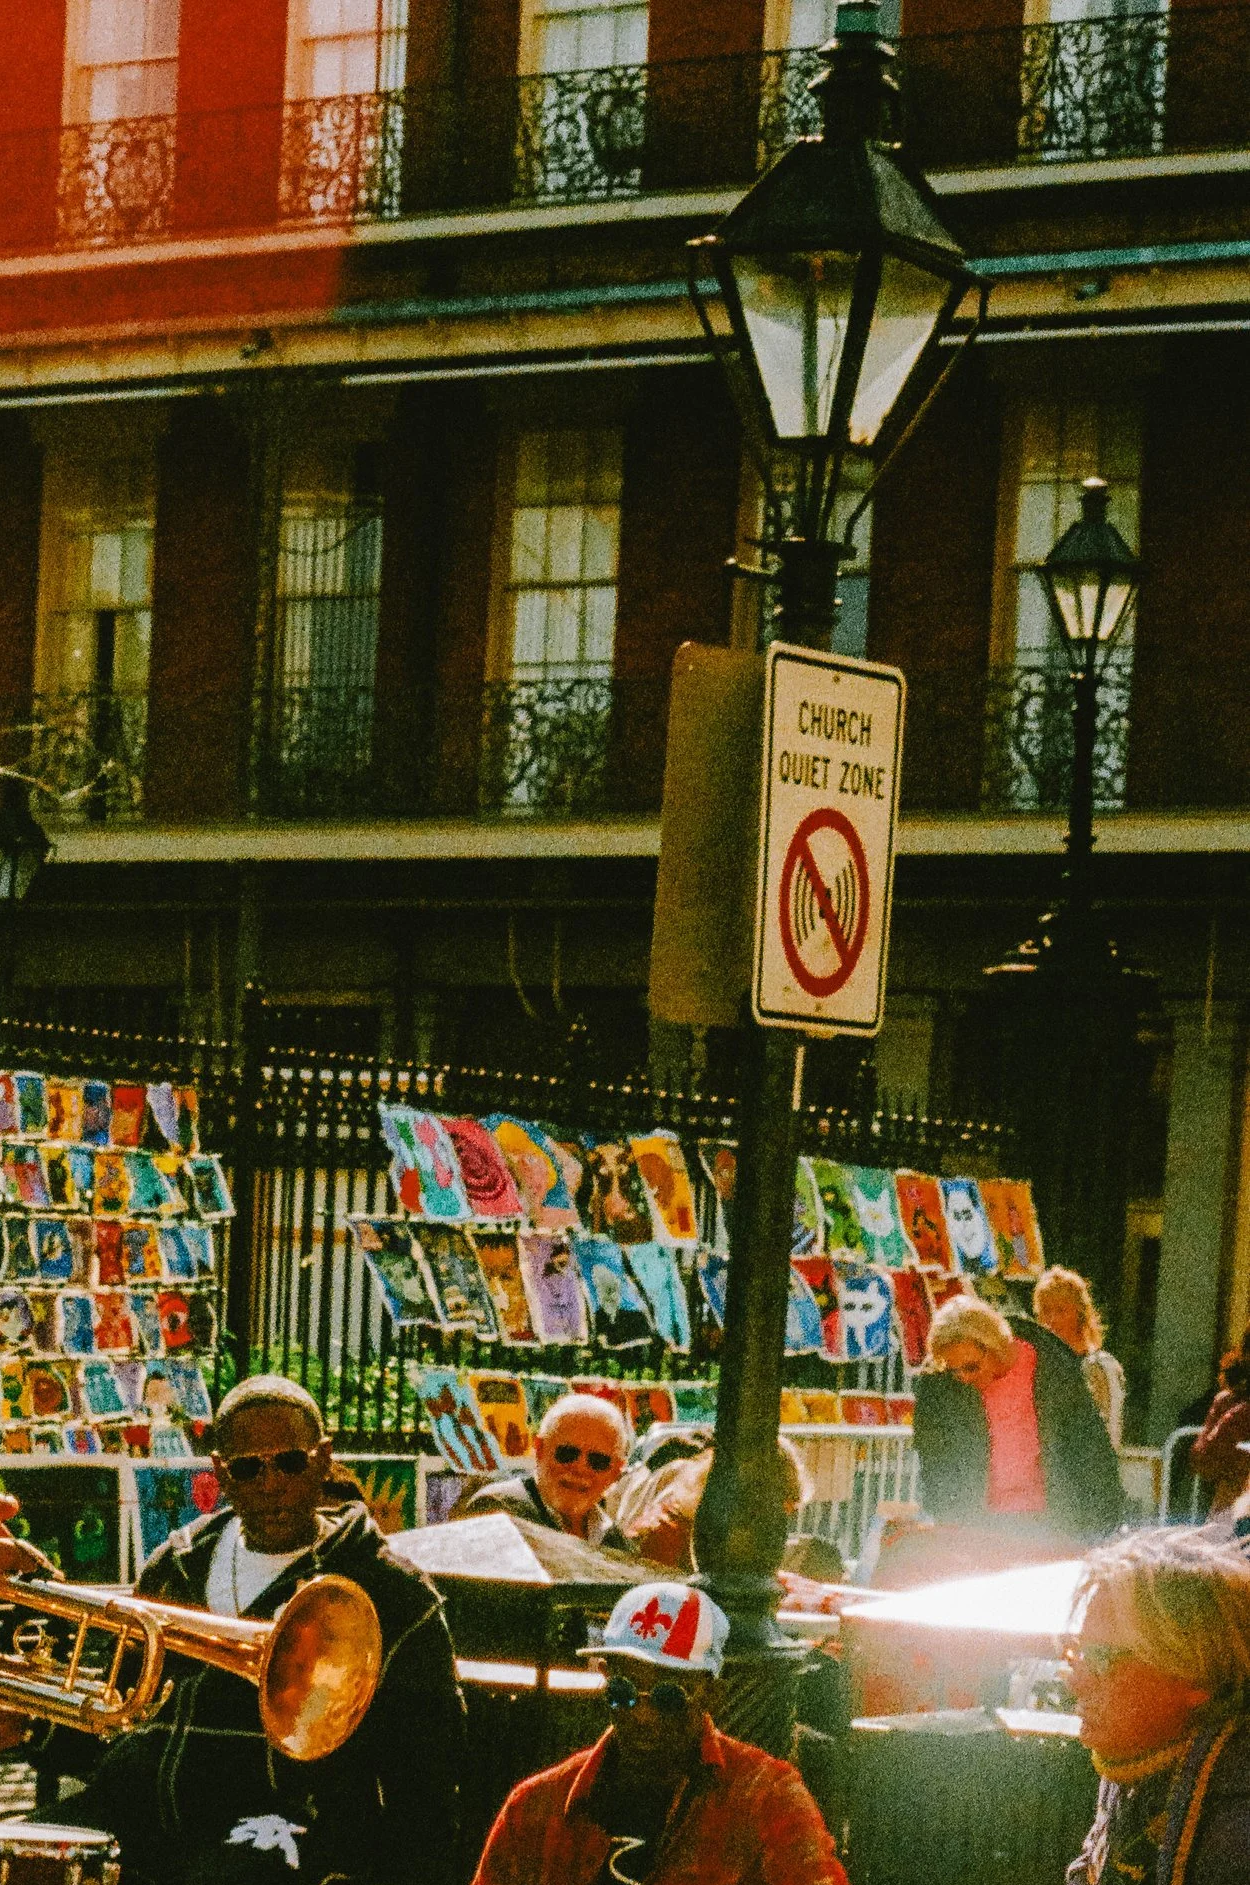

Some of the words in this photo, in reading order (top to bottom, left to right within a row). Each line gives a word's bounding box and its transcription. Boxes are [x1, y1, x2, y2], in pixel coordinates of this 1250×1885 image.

[798, 700, 872, 746] CHURCH
[778, 750, 831, 790] QUIET
[838, 761, 886, 801] ZONE
